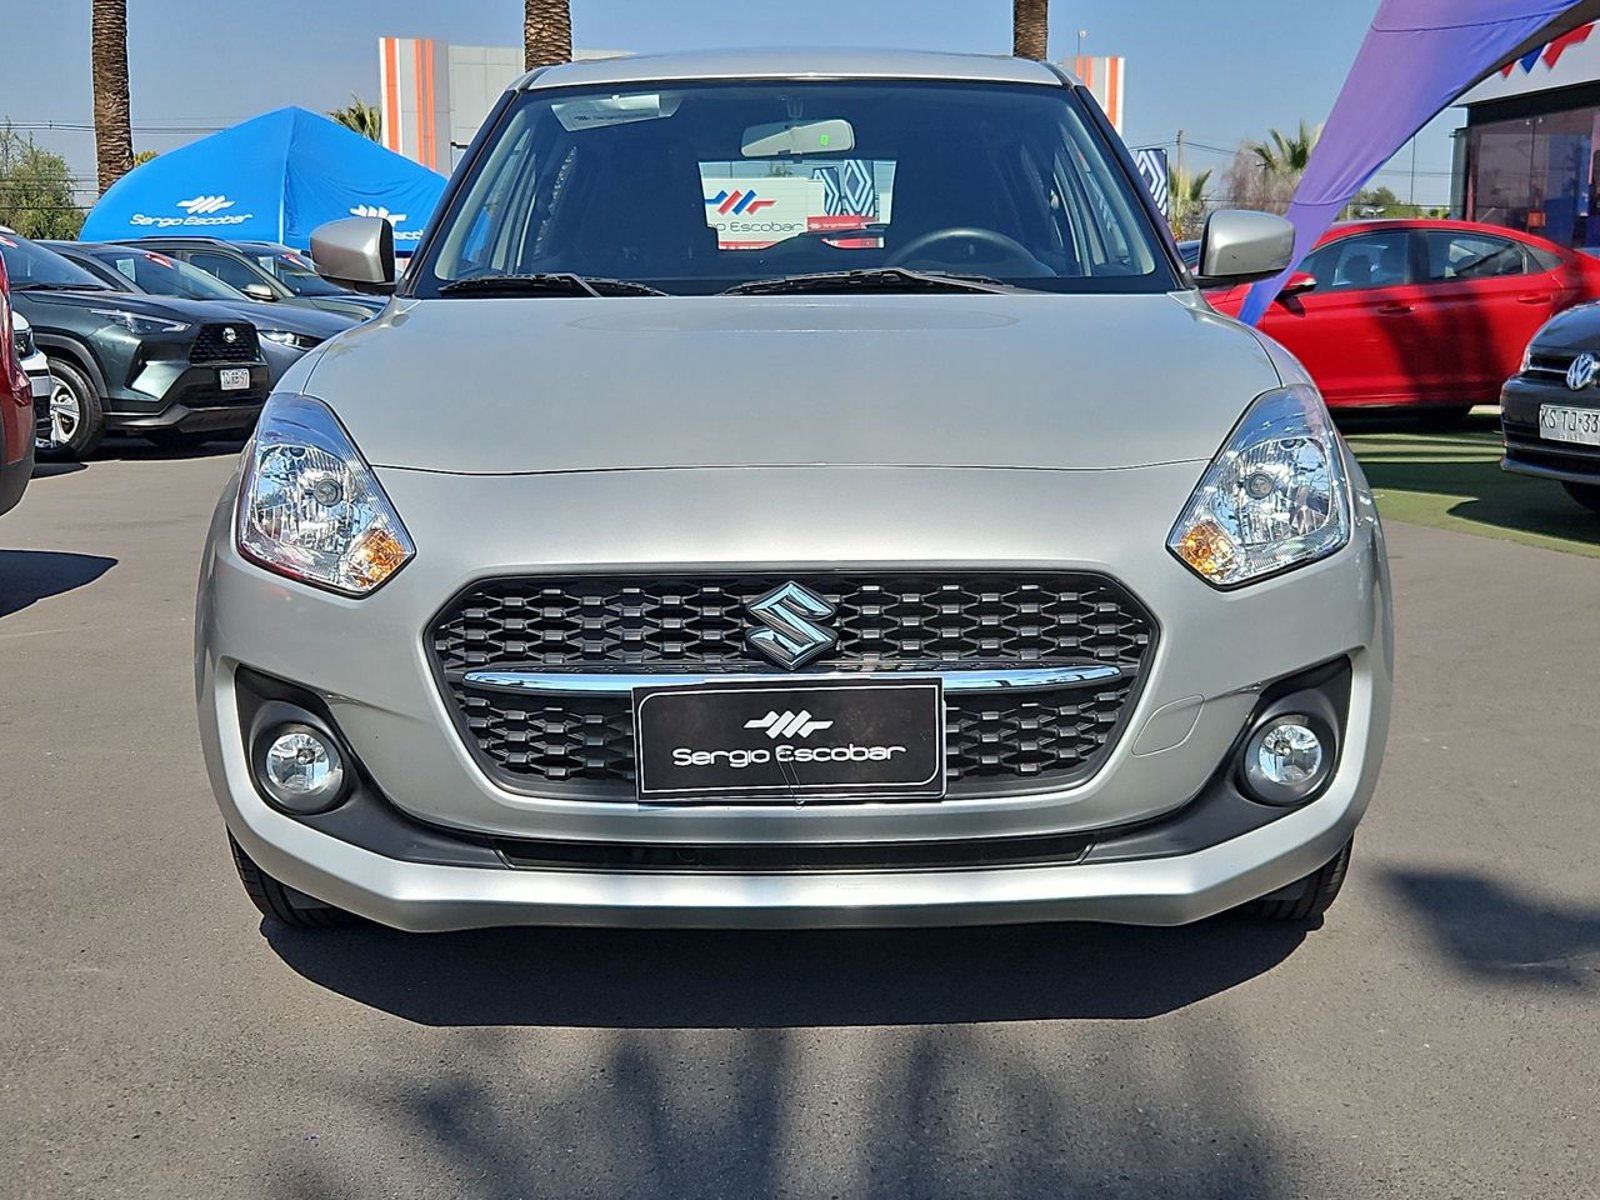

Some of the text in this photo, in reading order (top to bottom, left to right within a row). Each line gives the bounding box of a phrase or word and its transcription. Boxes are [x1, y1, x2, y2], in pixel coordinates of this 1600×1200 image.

[183, 213, 253, 226] Escobar
[729, 221, 804, 232] Escobar
[672, 743, 907, 768] Sergio Escobar
